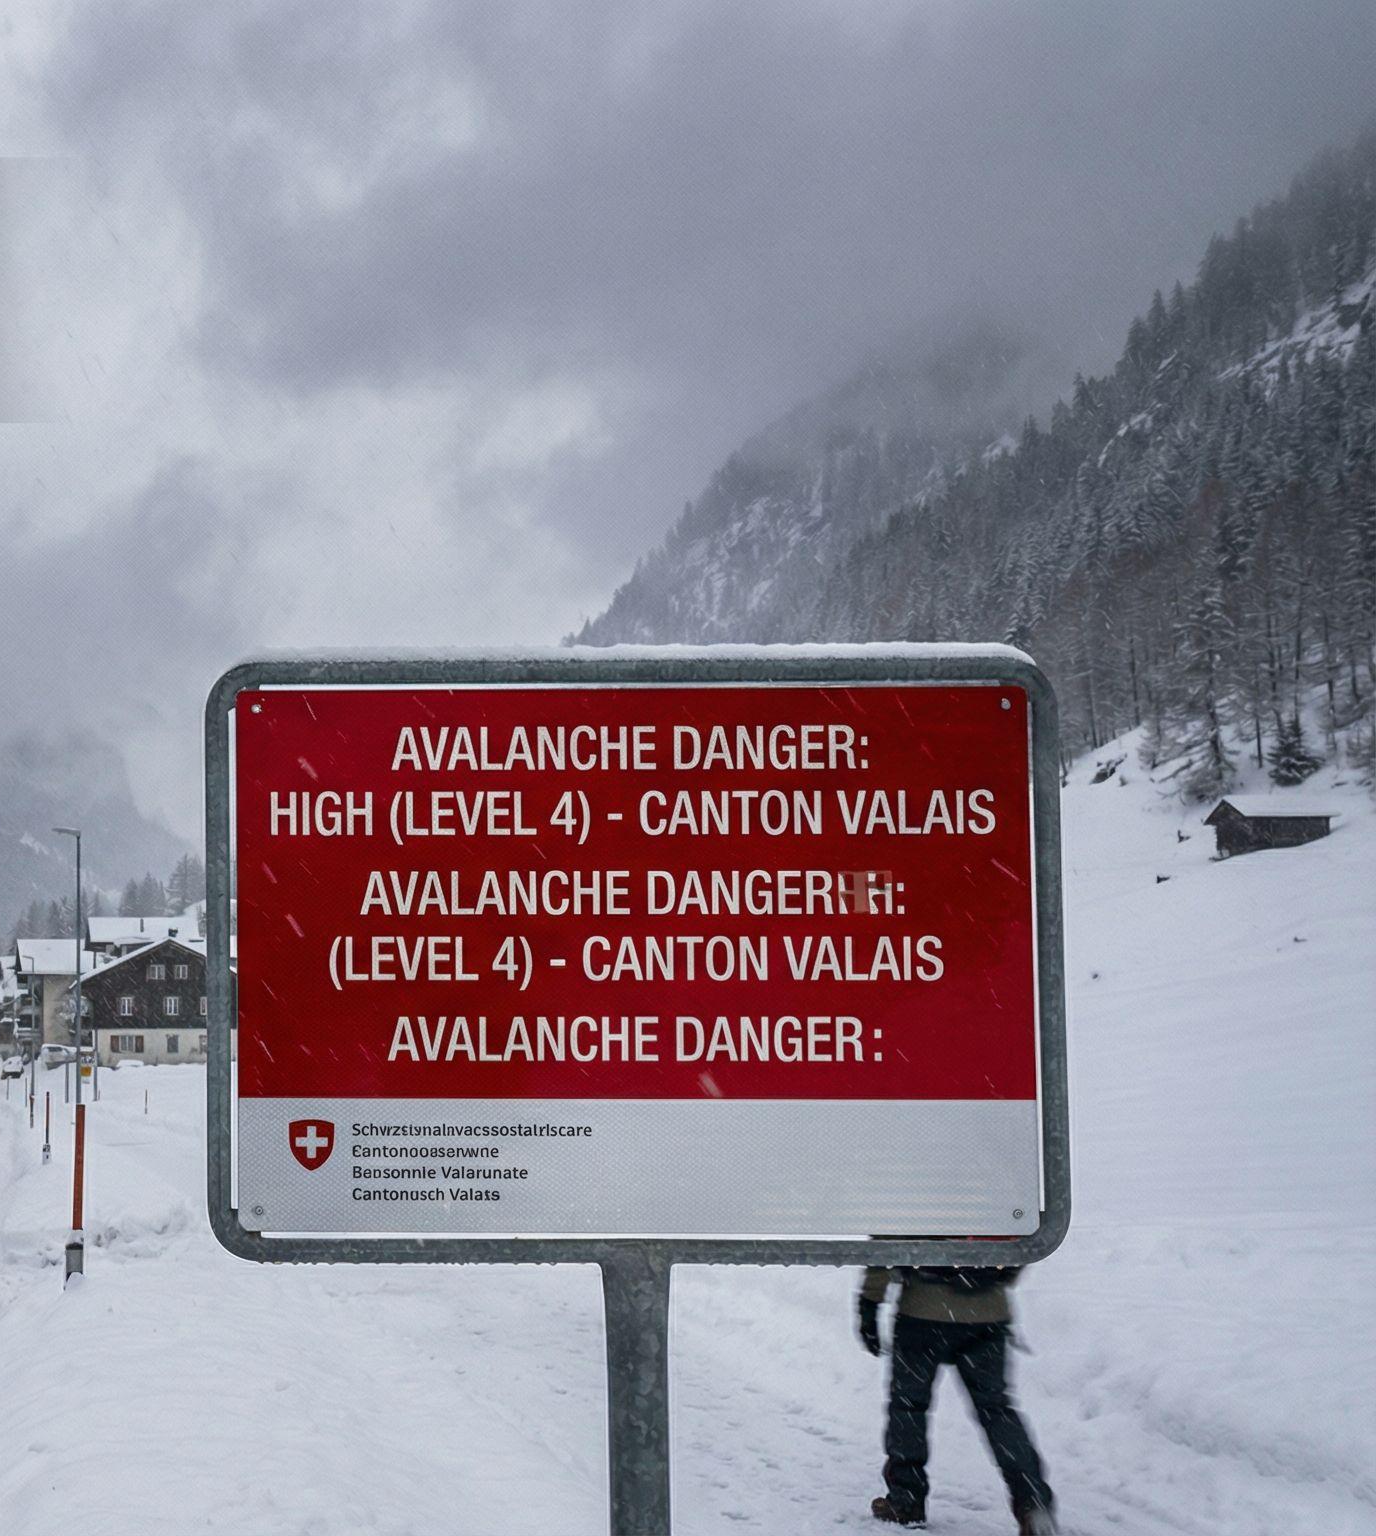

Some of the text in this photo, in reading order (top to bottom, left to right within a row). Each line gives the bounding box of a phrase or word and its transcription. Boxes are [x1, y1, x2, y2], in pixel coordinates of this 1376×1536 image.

[391, 724, 869, 771] AVALANCHE DANGER:
[270, 790, 373, 837] HIGH
[389, 791, 538, 846] (LEVEL
[549, 790, 591, 845] 4)
[639, 789, 822, 836] CANTON
[836, 788, 996, 835] VALAIS
[359, 870, 631, 916] AVALANCHE
[329, 936, 479, 991] (LEVEL
[492, 936, 533, 991] 4)
[582, 935, 768, 982] CANTON
[782, 935, 944, 982] VALAIS
[387, 1015, 659, 1062] AVALANCHE
